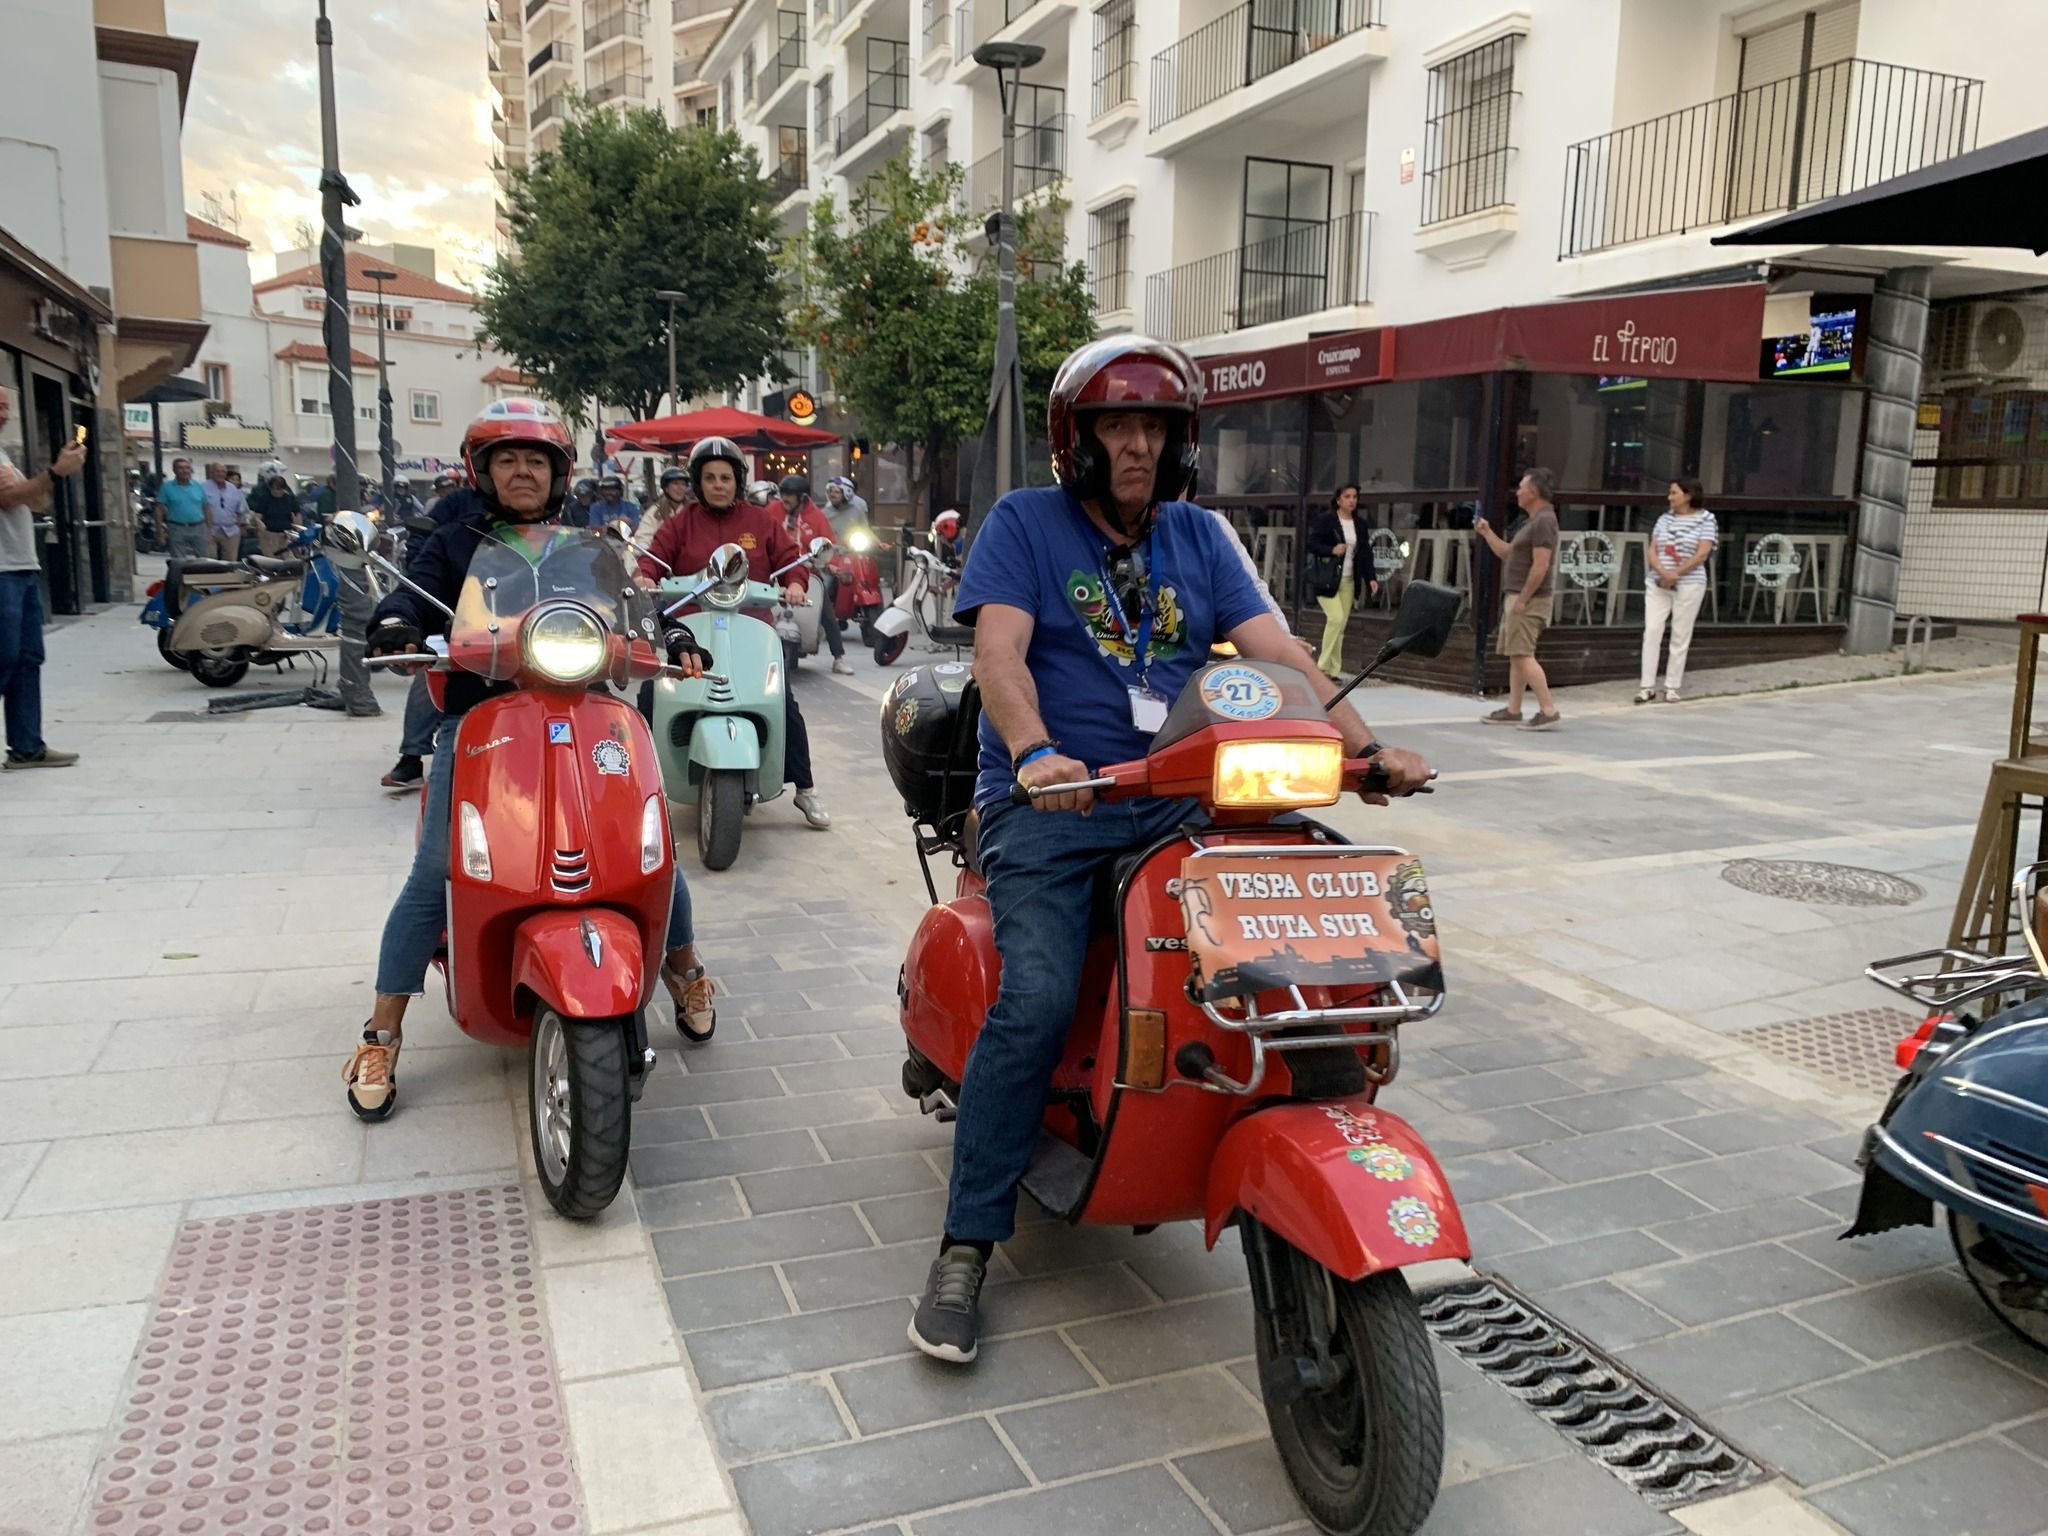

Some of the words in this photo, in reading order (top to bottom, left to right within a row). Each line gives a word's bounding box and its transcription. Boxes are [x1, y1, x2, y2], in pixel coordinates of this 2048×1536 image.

[1592, 334, 1610, 362] EL
[1616, 319, 1678, 365] TERCIO
[1318, 347, 1361, 365] Cruzcampo
[1212, 360, 1266, 393] TERCIO
[1226, 683, 1252, 701] 27
[465, 736, 514, 757] Vespa
[1216, 872, 1303, 899] VESPA
[1306, 871, 1381, 898] CLUB
[1237, 914, 1318, 940] RUTA
[1319, 913, 1380, 938] SUR
